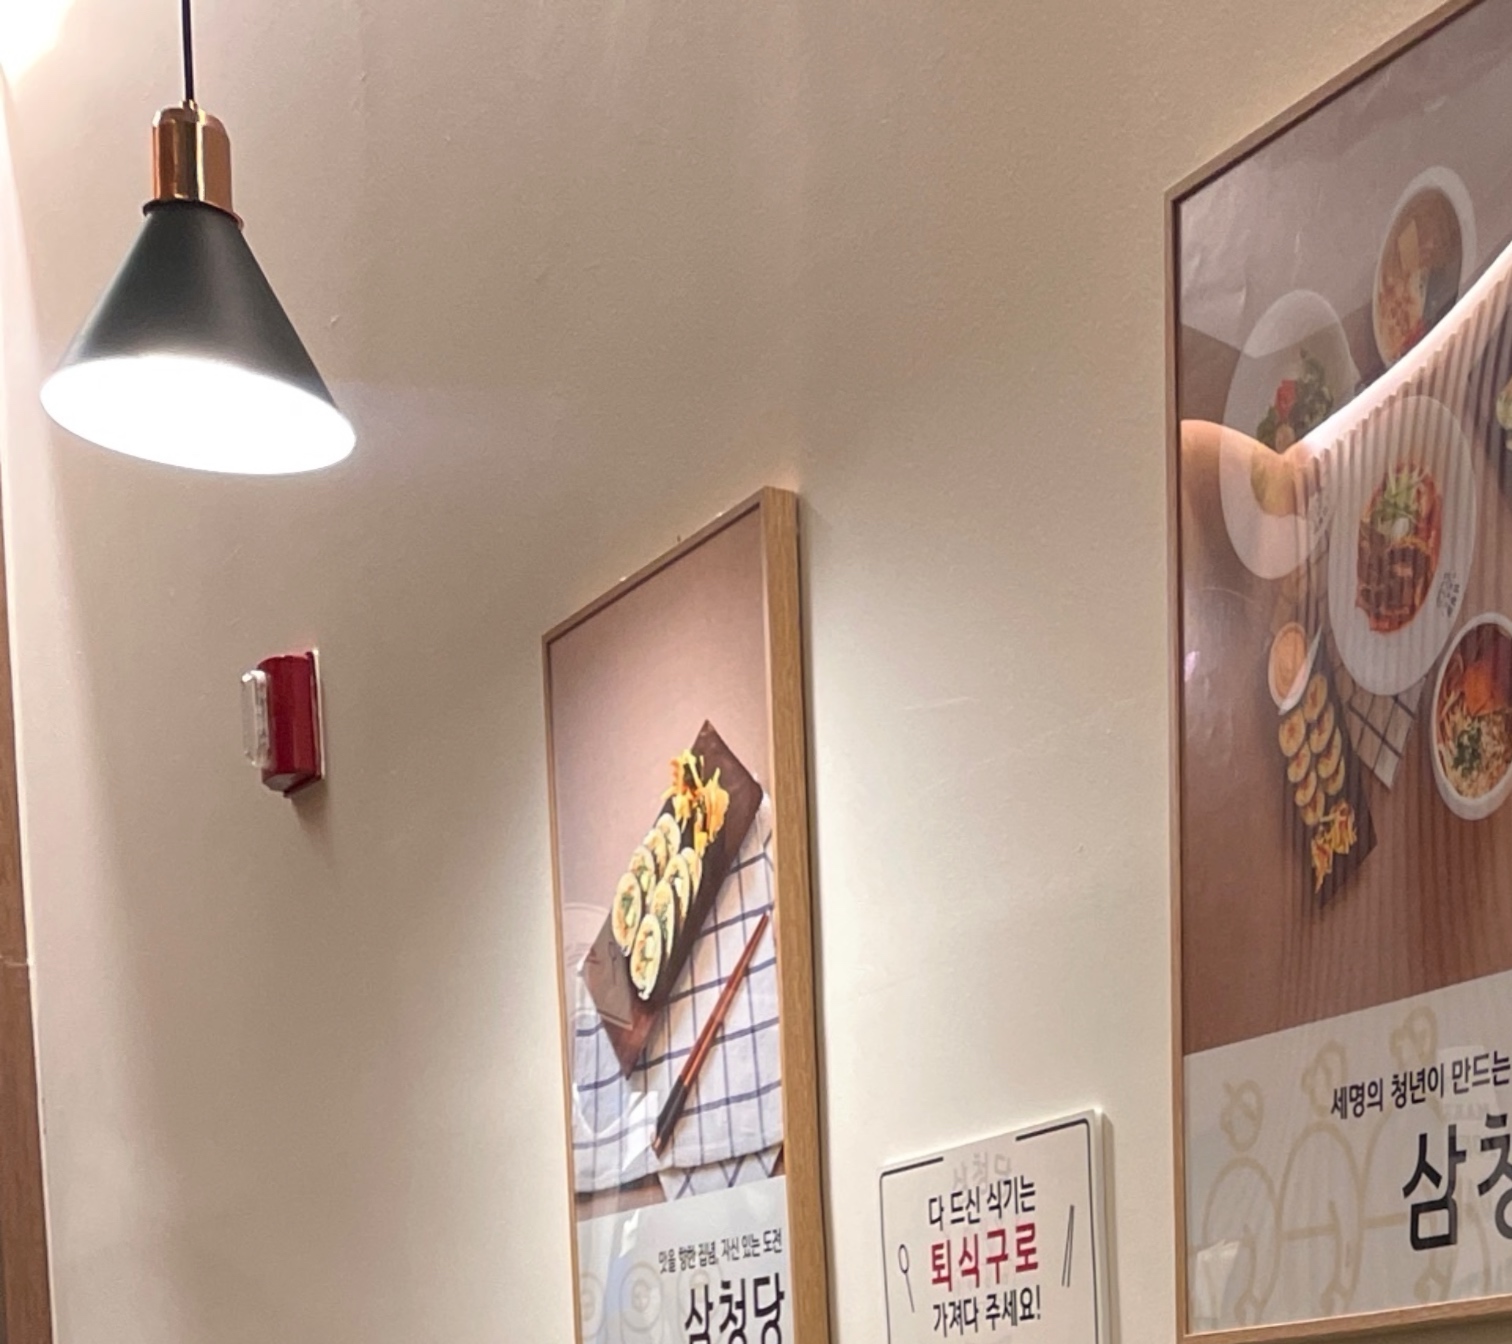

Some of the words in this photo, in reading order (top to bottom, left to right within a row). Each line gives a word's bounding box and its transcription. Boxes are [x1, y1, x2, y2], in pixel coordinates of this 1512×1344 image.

[1331, 1077, 1384, 1120] 세명의
[1390, 1062, 1444, 1109] 청년이
[1451, 1050, 1511, 1096] 만드는
[928, 1195, 944, 1231] 다
[950, 1186, 980, 1225] 드신
[986, 1175, 1036, 1219] 식기는
[721, 1236, 739, 1261] 자신
[742, 1233, 760, 1259] 있는
[763, 1228, 782, 1254] 도전
[931, 1222, 1038, 1292] 퇴식구로
[933, 1296, 979, 1338] 가져다
[985, 1285, 1041, 1331] 주세요!
